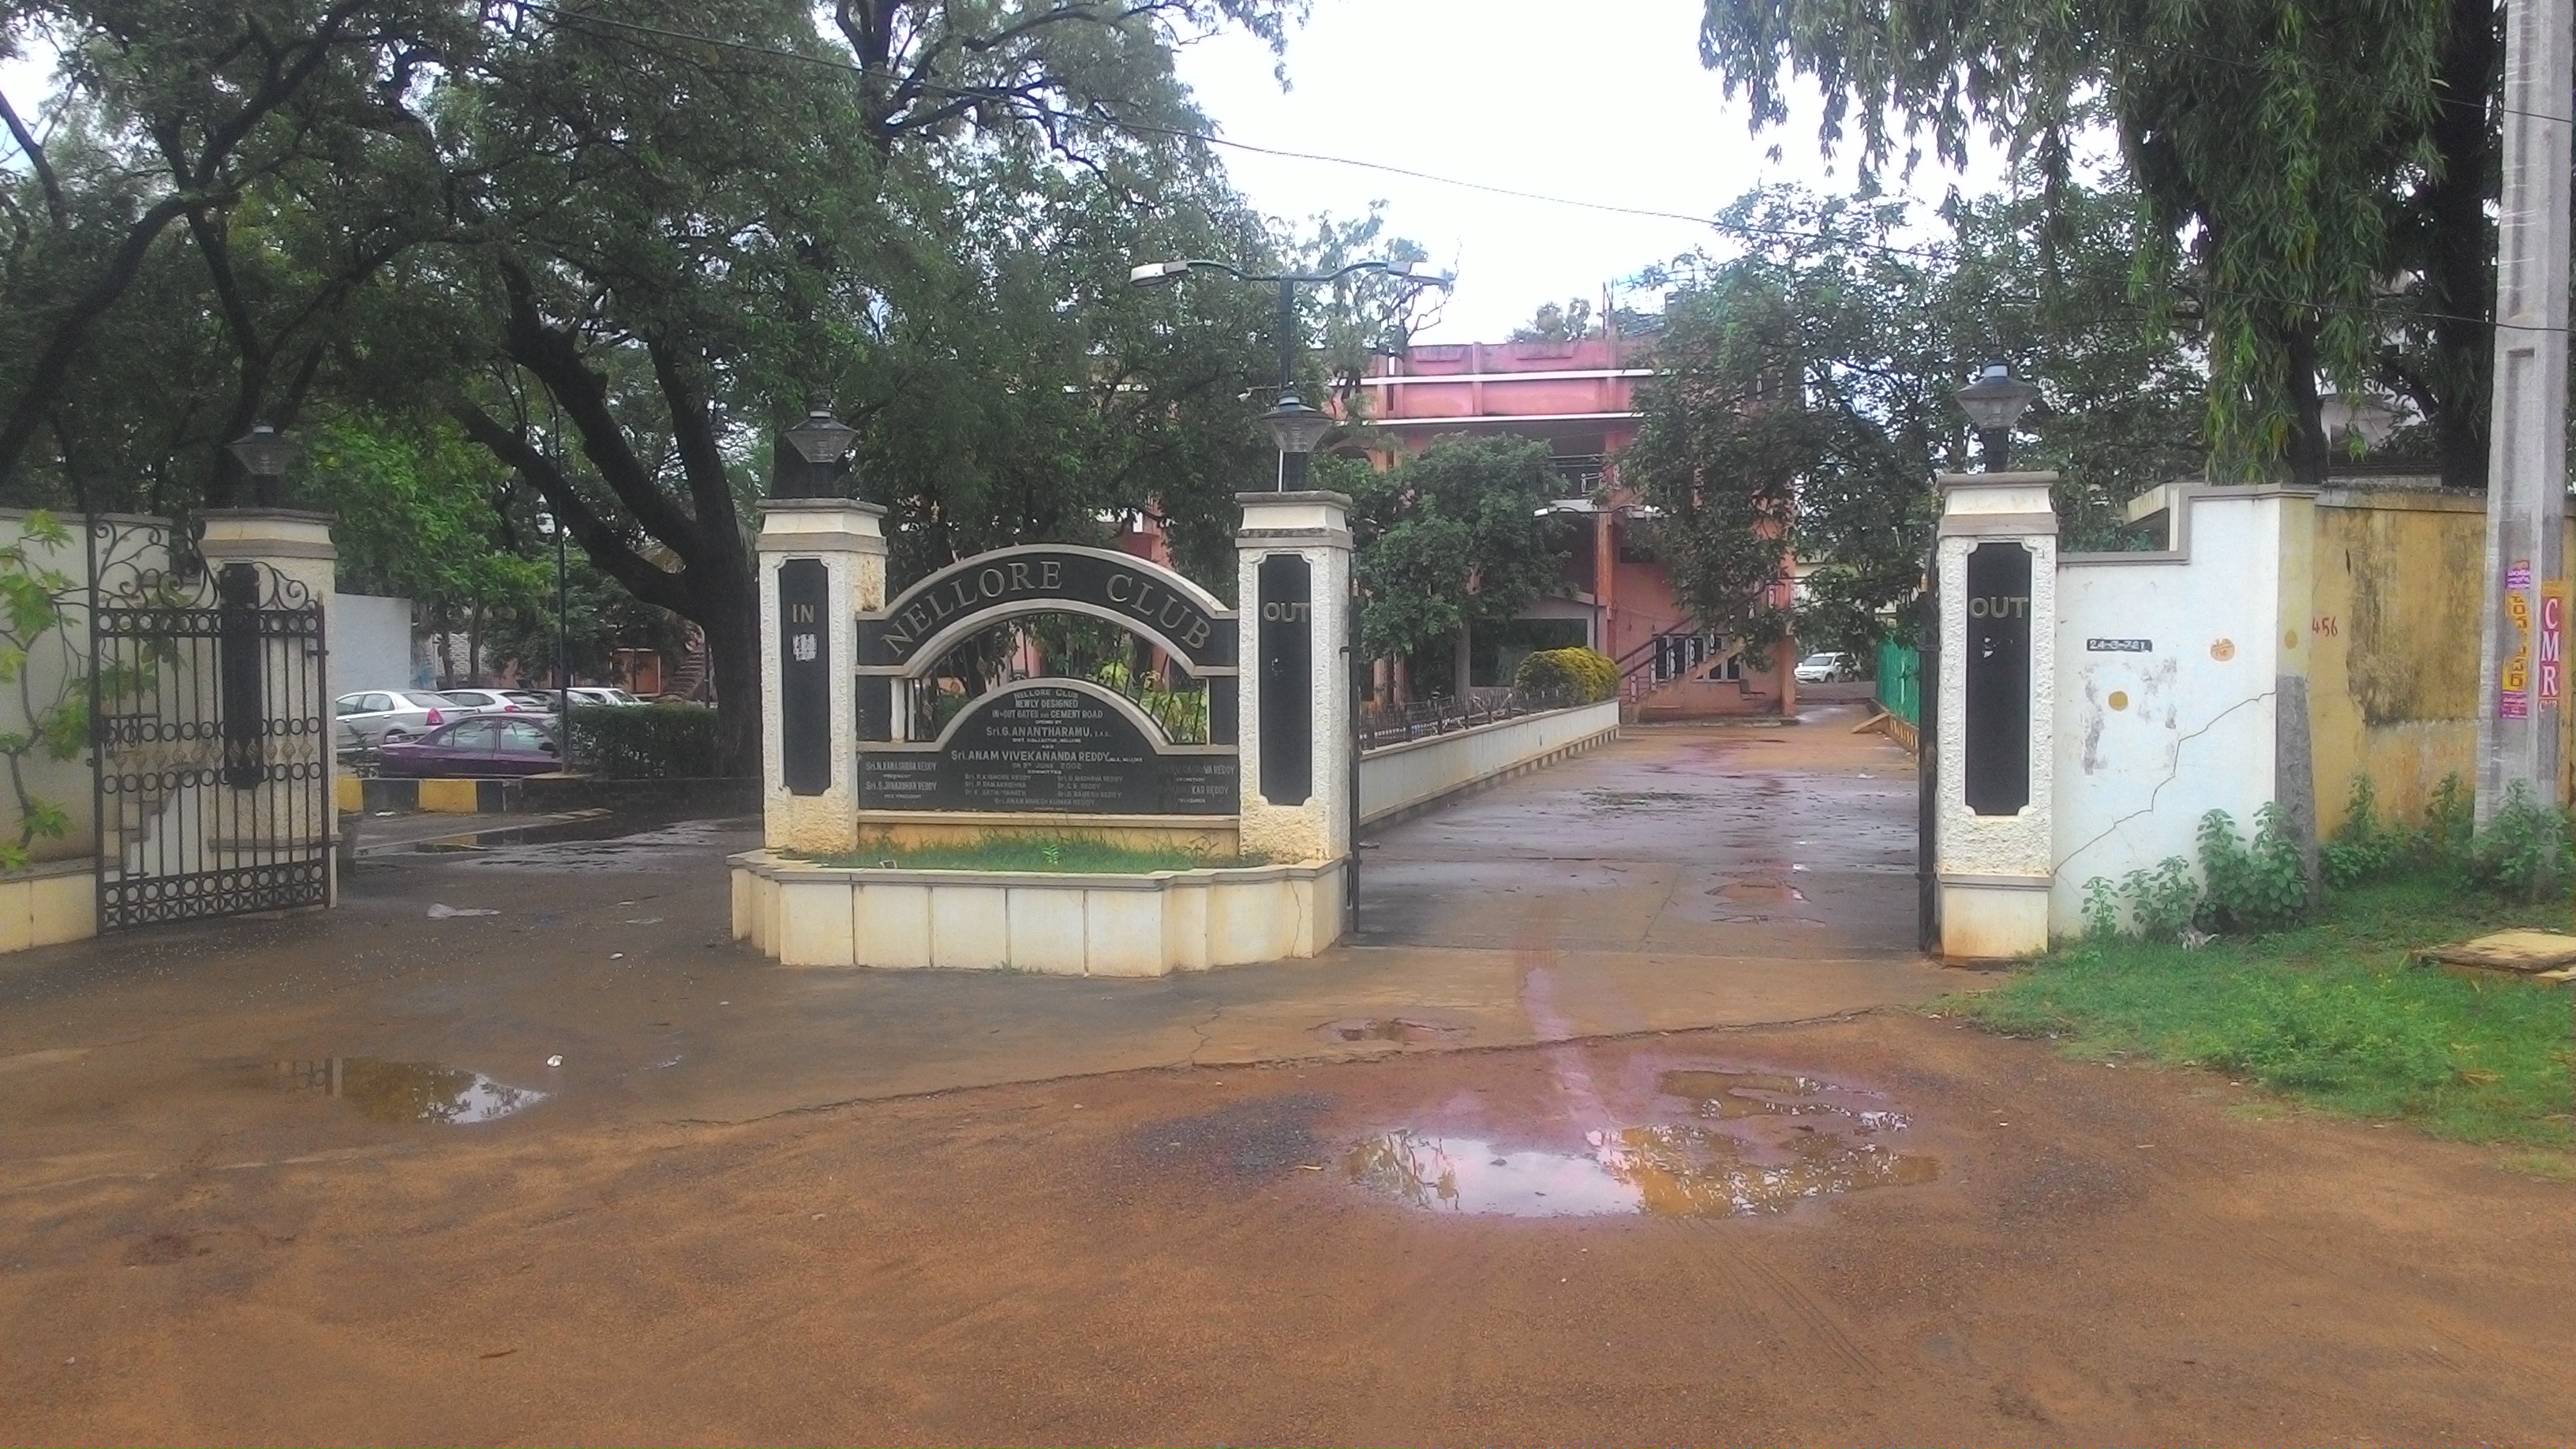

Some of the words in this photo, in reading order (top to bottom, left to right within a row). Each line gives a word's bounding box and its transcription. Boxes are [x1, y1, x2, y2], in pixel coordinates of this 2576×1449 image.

[792, 604, 814, 623] IN
[881, 561, 1062, 657] NELLORE
[1106, 574, 1212, 650] CLUB
[1263, 601, 1310, 622] OUT
[1969, 596, 2029, 619] OUT
[2312, 616, 2338, 637] 456
[2540, 597, 2559, 696] CMR
[1013, 688, 1050, 699] NELLORE
[1056, 689, 1079, 699] CLUB
[1015, 699, 1039, 708] NEWLY
[1041, 699, 1078, 708] DESIGNED
[1002, 751, 1076, 762] VIVEKANANDA
